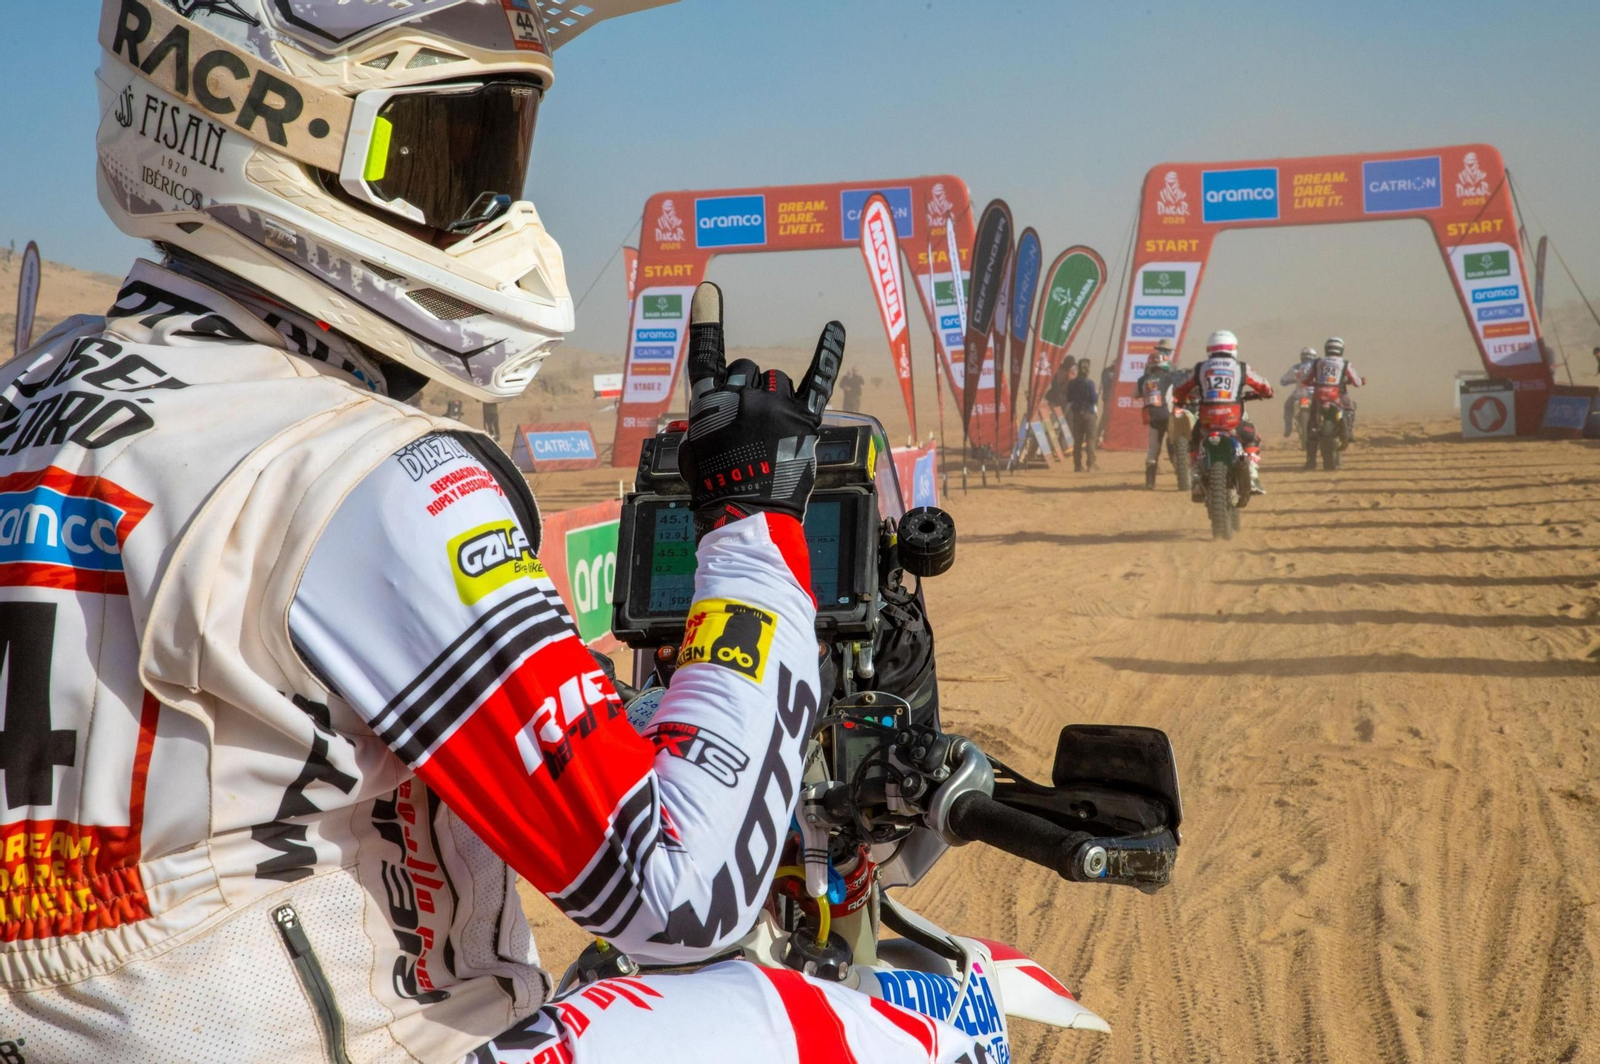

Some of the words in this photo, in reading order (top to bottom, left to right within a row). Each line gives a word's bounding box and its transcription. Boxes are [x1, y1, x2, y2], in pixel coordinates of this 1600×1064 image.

[516, 12, 534, 31] 44
[162, 155, 188, 177] 1920
[1293, 172, 1348, 185] DREAM.
[142, 165, 204, 211] IBÉRICOS
[1293, 185, 1335, 197] DARE.
[1206, 187, 1275, 203] aramco
[778, 201, 828, 213] DREAM.
[1157, 201, 1190, 215] DAKAR
[1294, 197, 1325, 209] LIVE
[1326, 196, 1344, 207] IT.
[699, 214, 762, 229] aramco
[778, 213, 817, 224] DARE.
[779, 224, 807, 235] LIVE
[809, 223, 825, 234] IT.
[1447, 219, 1503, 236] START
[1146, 239, 1199, 252] START
[918, 249, 968, 265] STAT
[644, 264, 694, 277] START
[870, 218, 902, 322] MOTUL
[974, 217, 1006, 324] DEFENDER
[1475, 288, 1517, 299] aramco
[1137, 308, 1176, 317] aramco
[638, 330, 676, 339] aramco
[634, 383, 654, 391] STAGE
[656, 383, 662, 391] 2
[1206, 377, 1232, 390] 129
[534, 438, 590, 453] CATRION
[704, 461, 770, 491] RIDER
[426, 494, 454, 517] ROPA
[659, 515, 689, 525] 45.1
[0, 503, 118, 555] amco
[658, 532, 681, 540] 12.9
[657, 548, 689, 558] 45.3
[658, 723, 699, 736] BIKES
[646, 660, 818, 948] MOTS
